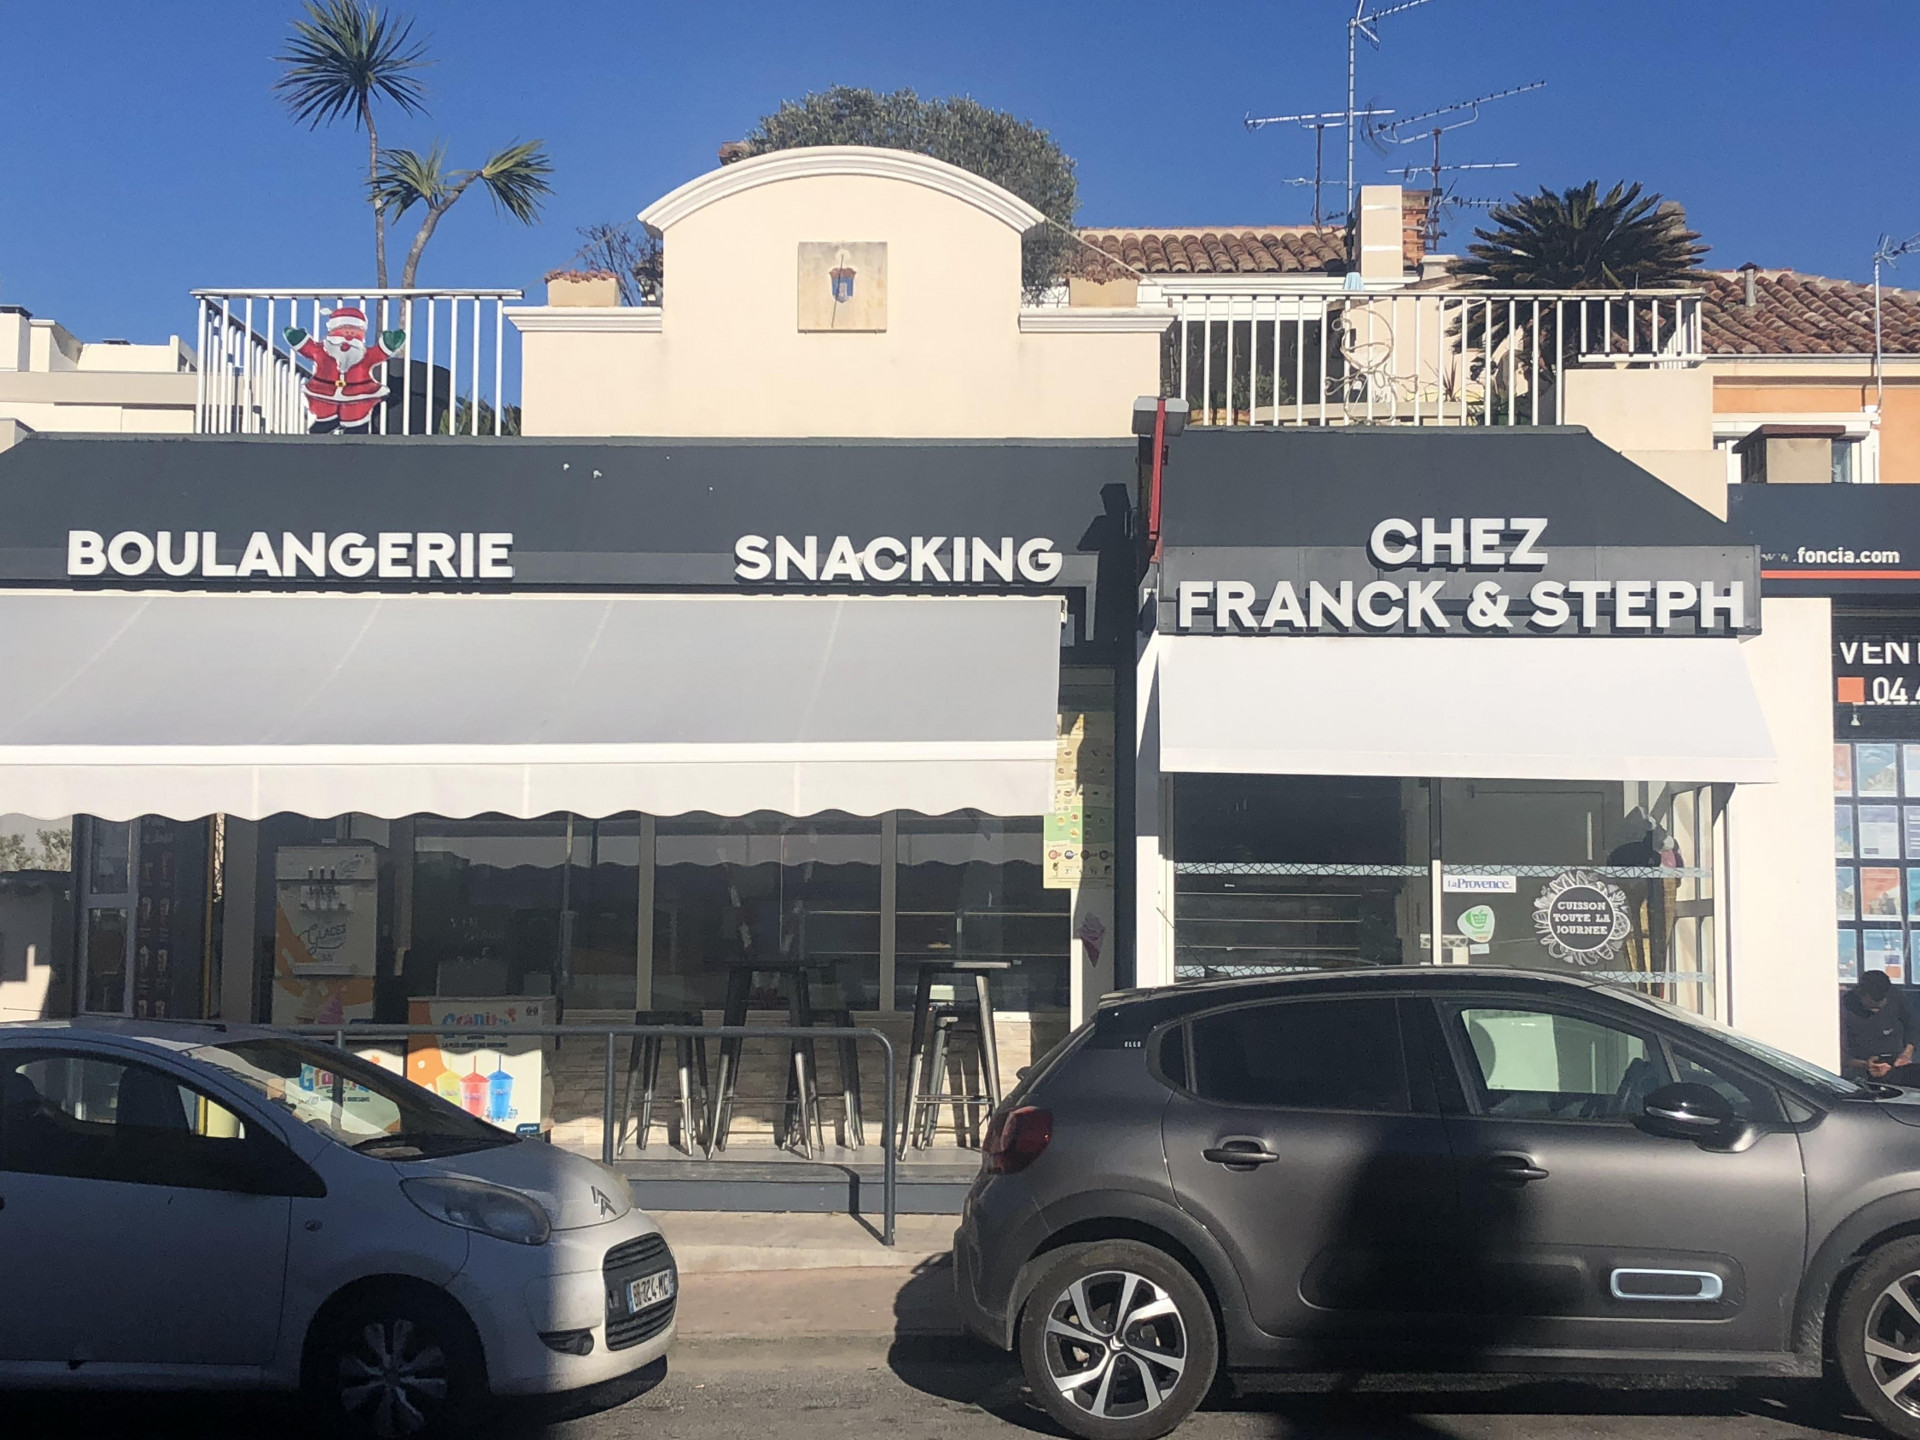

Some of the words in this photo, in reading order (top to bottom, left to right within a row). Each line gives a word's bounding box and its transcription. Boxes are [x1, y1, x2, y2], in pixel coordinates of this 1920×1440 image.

[66, 529, 515, 579] BOULANGERIE
[735, 534, 1064, 583] SNACKING
[1370, 517, 1549, 566] CHEZ
[1178, 580, 1451, 629] FRANCK
[1466, 580, 1514, 629] &
[1530, 580, 1745, 629] STEPH
[1840, 642, 1920, 664] VEN
[1553, 913, 1591, 922] TOUTE
[1595, 914, 1611, 923] LA
[1557, 901, 1606, 911] CUISSON
